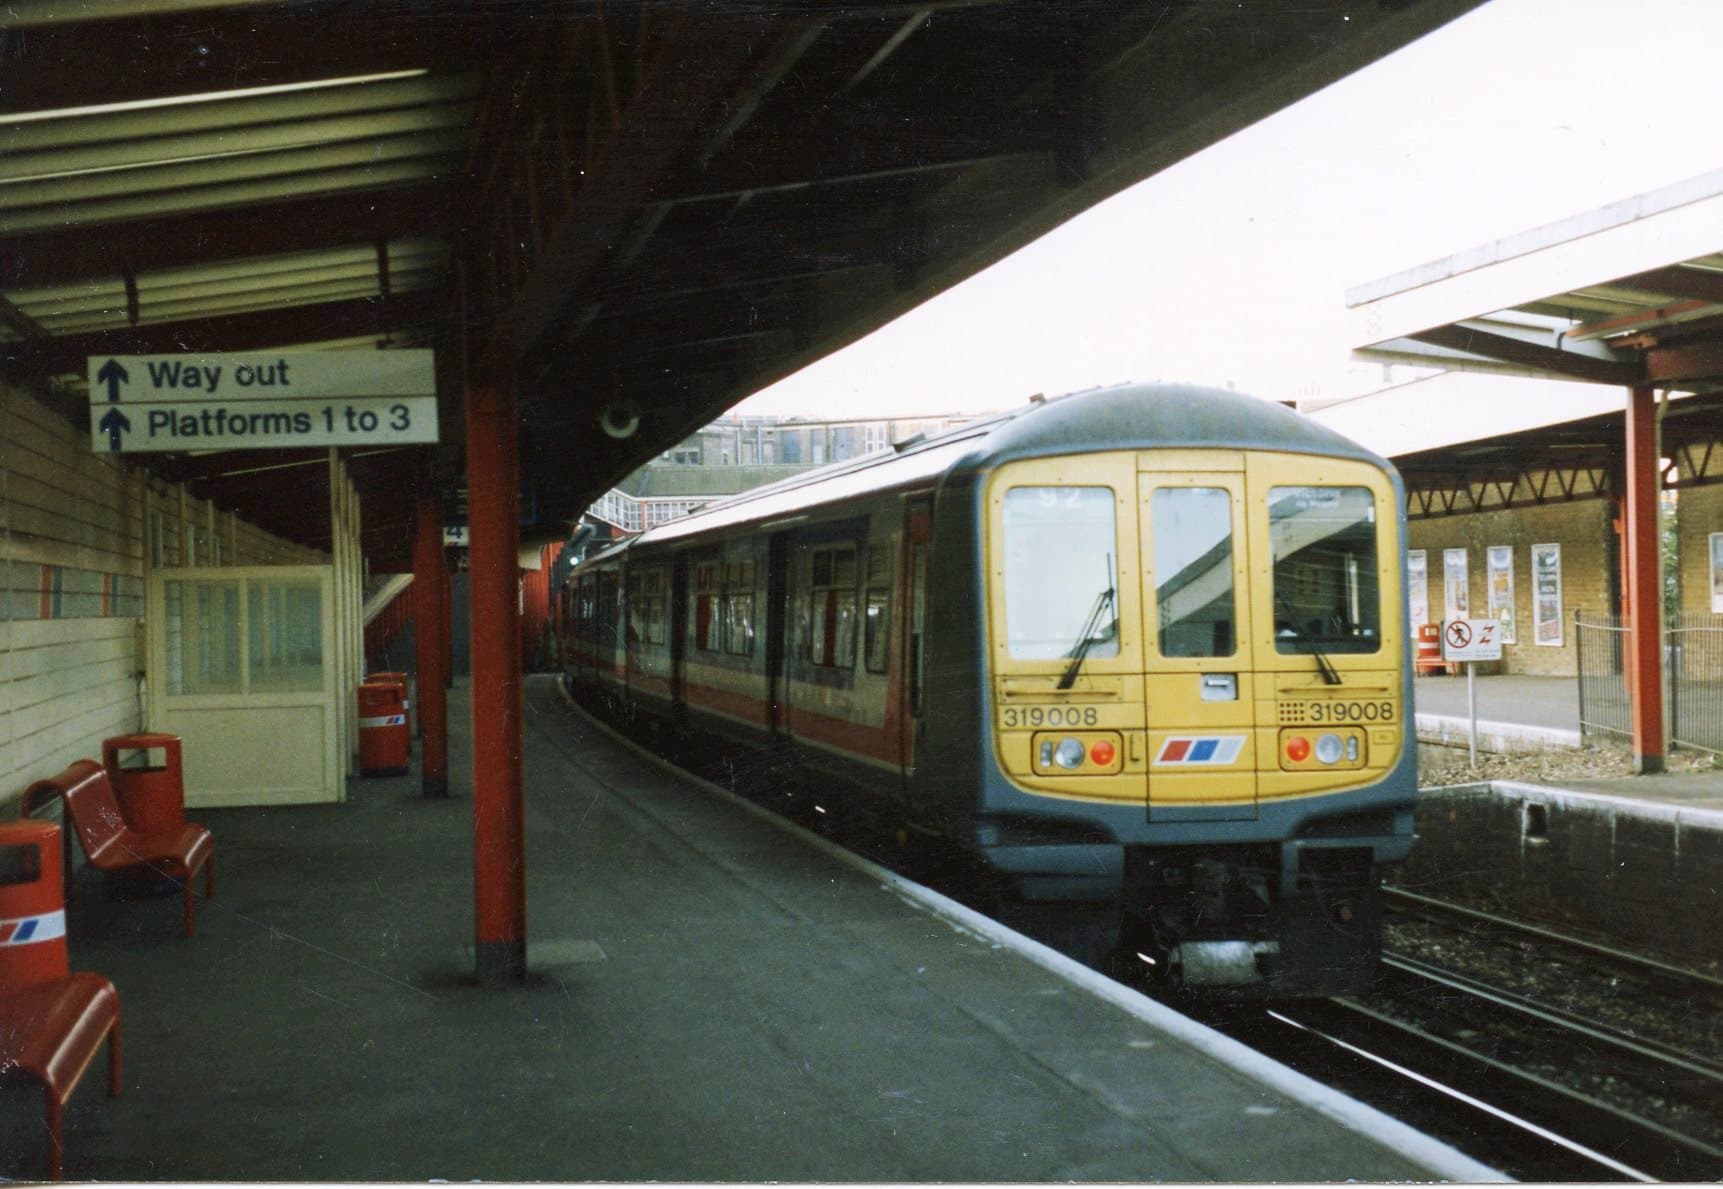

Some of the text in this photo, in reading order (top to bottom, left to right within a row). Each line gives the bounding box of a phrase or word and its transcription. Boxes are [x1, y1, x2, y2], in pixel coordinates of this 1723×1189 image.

[147, 358, 290, 393] Way out
[148, 404, 411, 438] Platforms 1 to 3
[446, 526, 463, 539] 4
[1004, 707, 1097, 727] 319008
[1309, 702, 1393, 721] 319008
